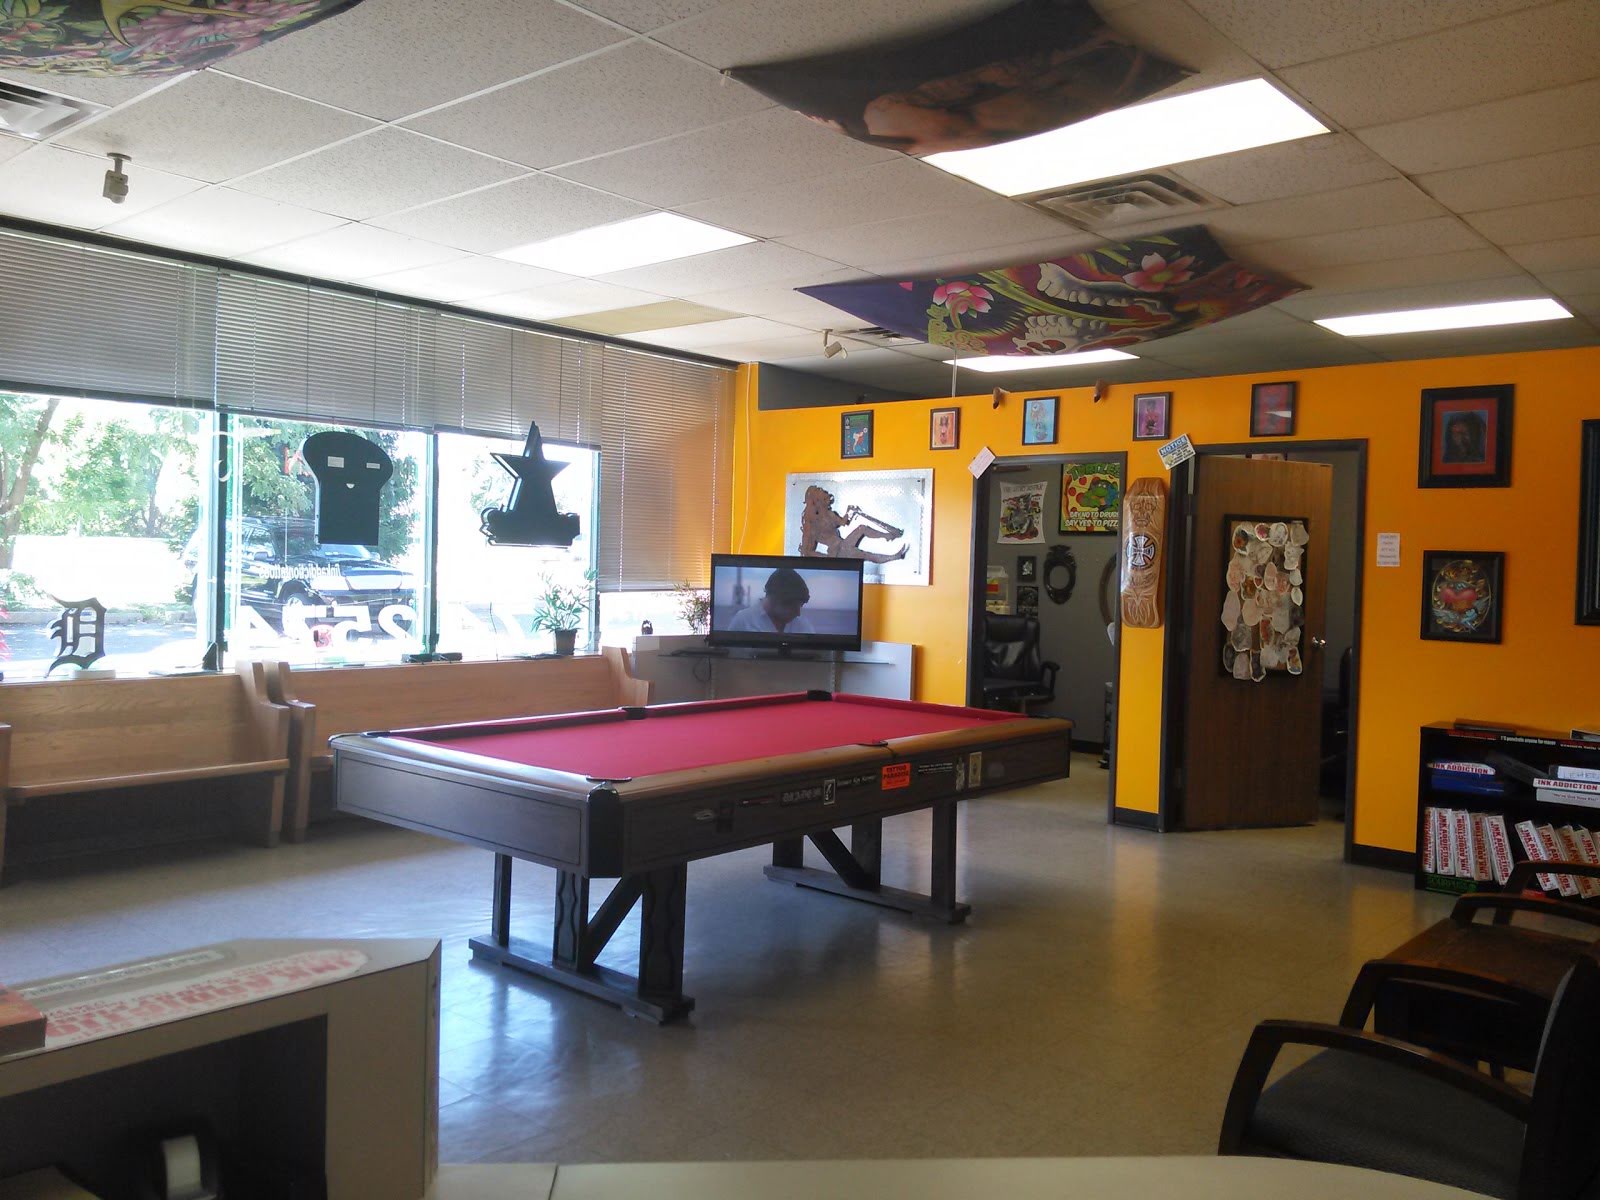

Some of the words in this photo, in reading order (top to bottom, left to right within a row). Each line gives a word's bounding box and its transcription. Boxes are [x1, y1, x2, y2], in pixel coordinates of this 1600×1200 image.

[1161, 436, 1187, 455] NOTICE
[1065, 519, 1078, 527] SAY
[1079, 519, 1092, 527] YES
[1093, 519, 1102, 527] TO
[1103, 519, 1119, 527] PIZZ
[1447, 764, 1489, 774] ADDICTION
[1553, 781, 1598, 791] ADDICTION
[1456, 818, 1465, 857] ADDICTION
[1475, 821, 1483, 862] ADDICTION
[1497, 837, 1509, 877] ADDICTION
